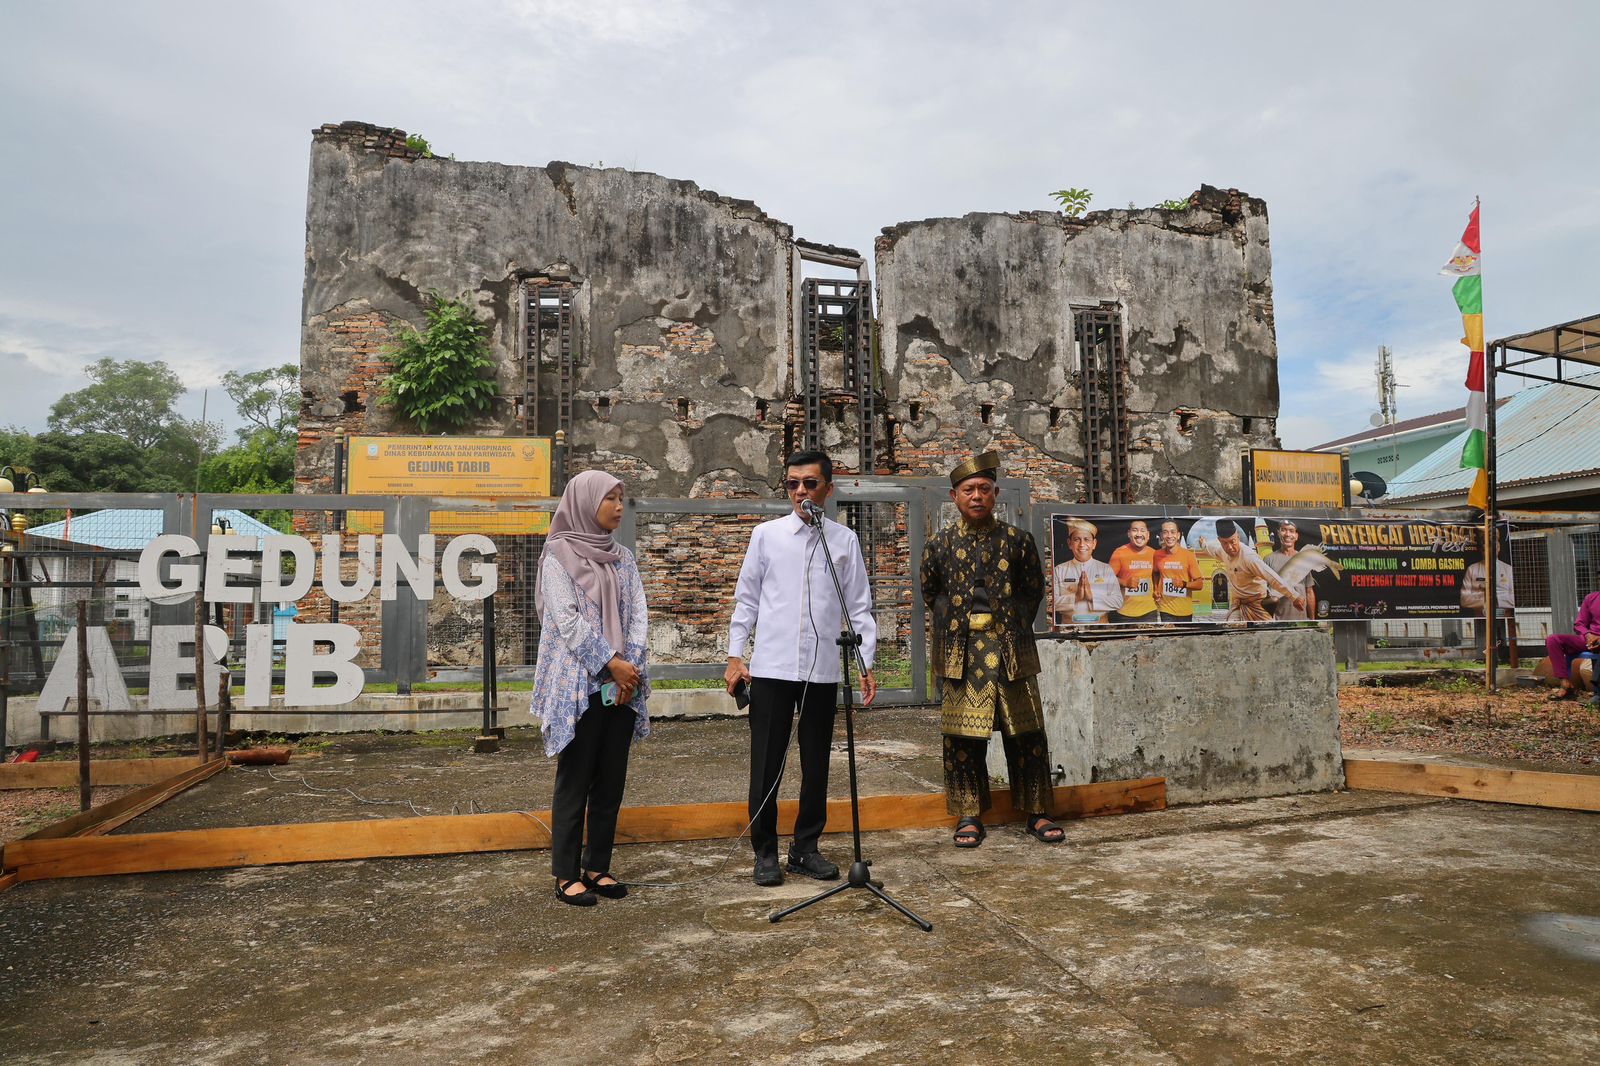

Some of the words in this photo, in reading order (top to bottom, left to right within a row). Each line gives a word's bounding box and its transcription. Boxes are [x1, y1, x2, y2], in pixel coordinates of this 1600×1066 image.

[408, 460, 454, 473] GEDUNG
[457, 461, 491, 473] TABIB
[1256, 469, 1287, 484] BANGUNAN
[1287, 470, 1296, 484] INI
[1296, 471, 1316, 485] RAWAN
[1258, 498, 1277, 507] THIS
[1278, 499, 1314, 508] BUILDING
[1319, 524, 1405, 545] PENYENGAT
[138, 533, 499, 606] GEDUNG
[1339, 558, 1367, 570] LOMBA
[1368, 558, 1398, 570] NYULUH
[1411, 558, 1437, 570] LOMBA
[1438, 558, 1465, 570] GASING
[1351, 574, 1394, 587] PENYENGAT
[1395, 574, 1419, 587] NIGHT
[1419, 575, 1434, 587] RUN
[1435, 574, 1441, 587] 5
[1442, 575, 1455, 587] KM
[37, 623, 366, 713] ABIB
